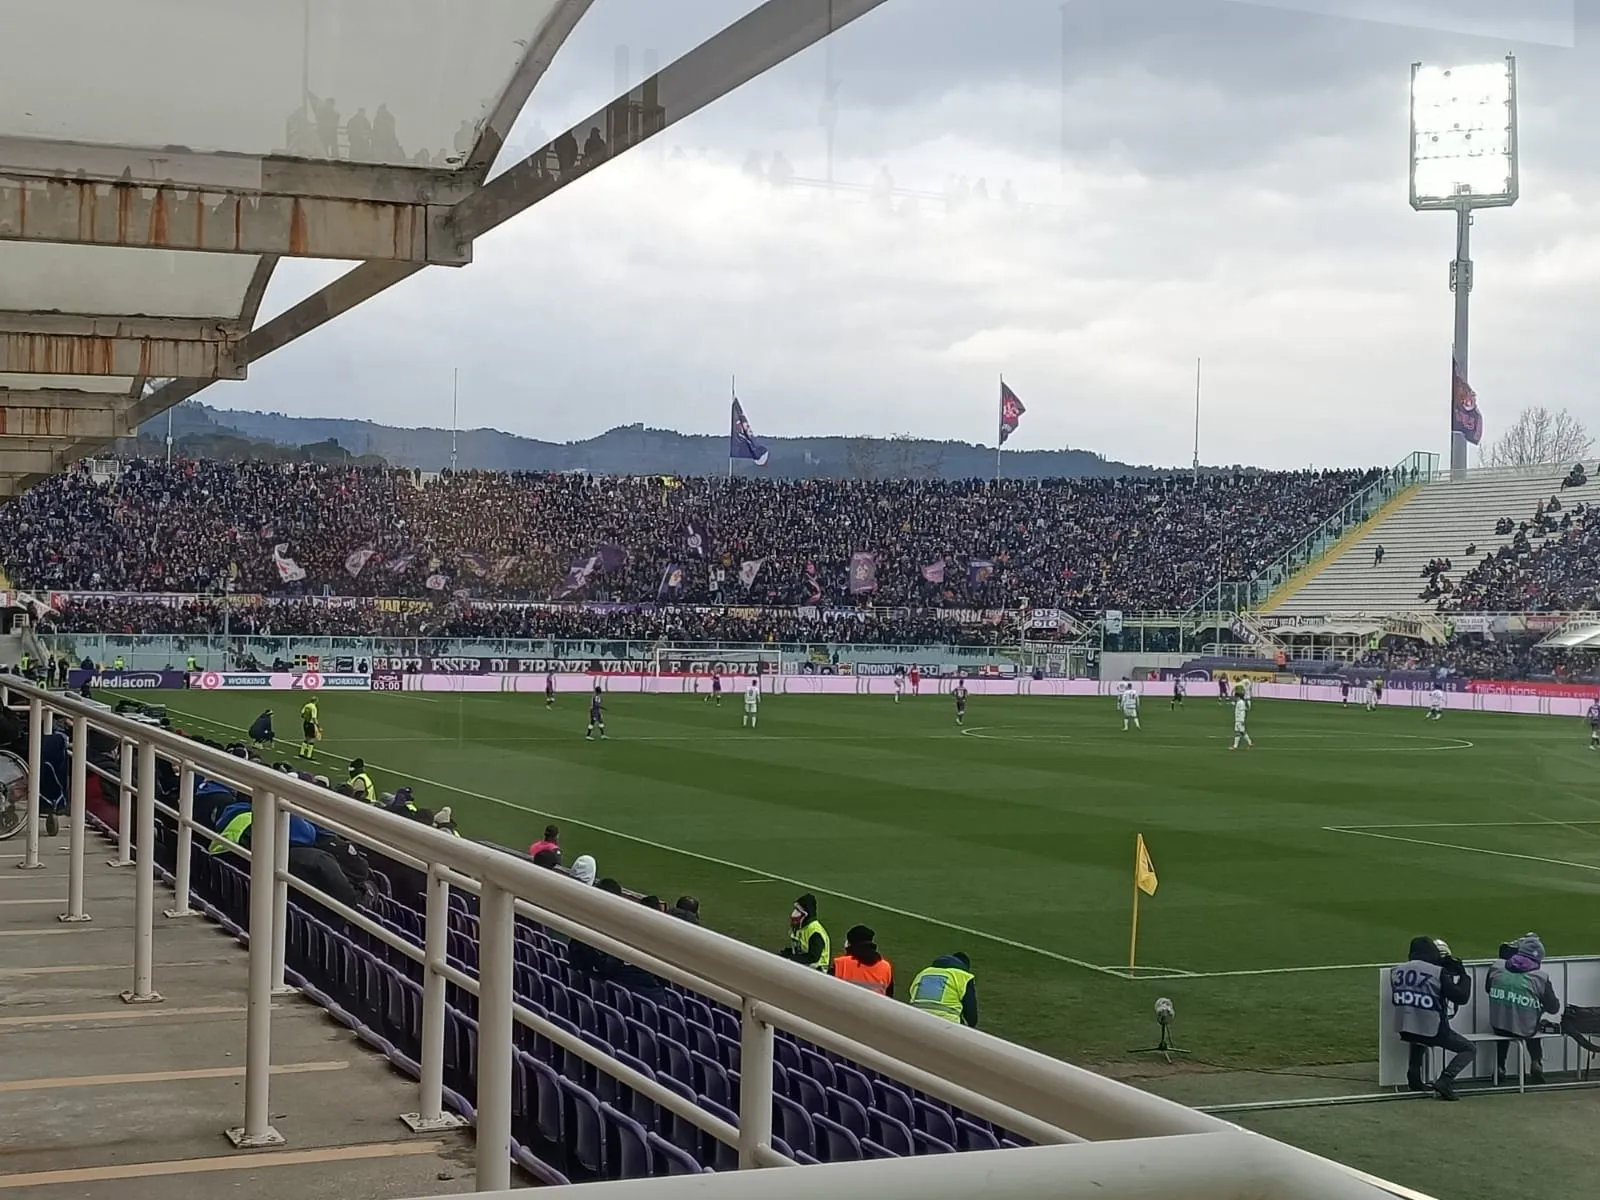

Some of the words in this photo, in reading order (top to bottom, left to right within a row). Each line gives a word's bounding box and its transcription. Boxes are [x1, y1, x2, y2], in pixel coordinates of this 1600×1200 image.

[430, 658, 481, 672] ESSER
[490, 659, 509, 672] DI
[518, 660, 592, 673] FIRENZE
[669, 661, 681, 674] E
[690, 661, 758, 676] GLORIA
[91, 675, 156, 688] Mediacom
[373, 682, 400, 690] 03:00
[1411, 681, 1457, 692] SUPPIER
[1394, 969, 1433, 987] 307
